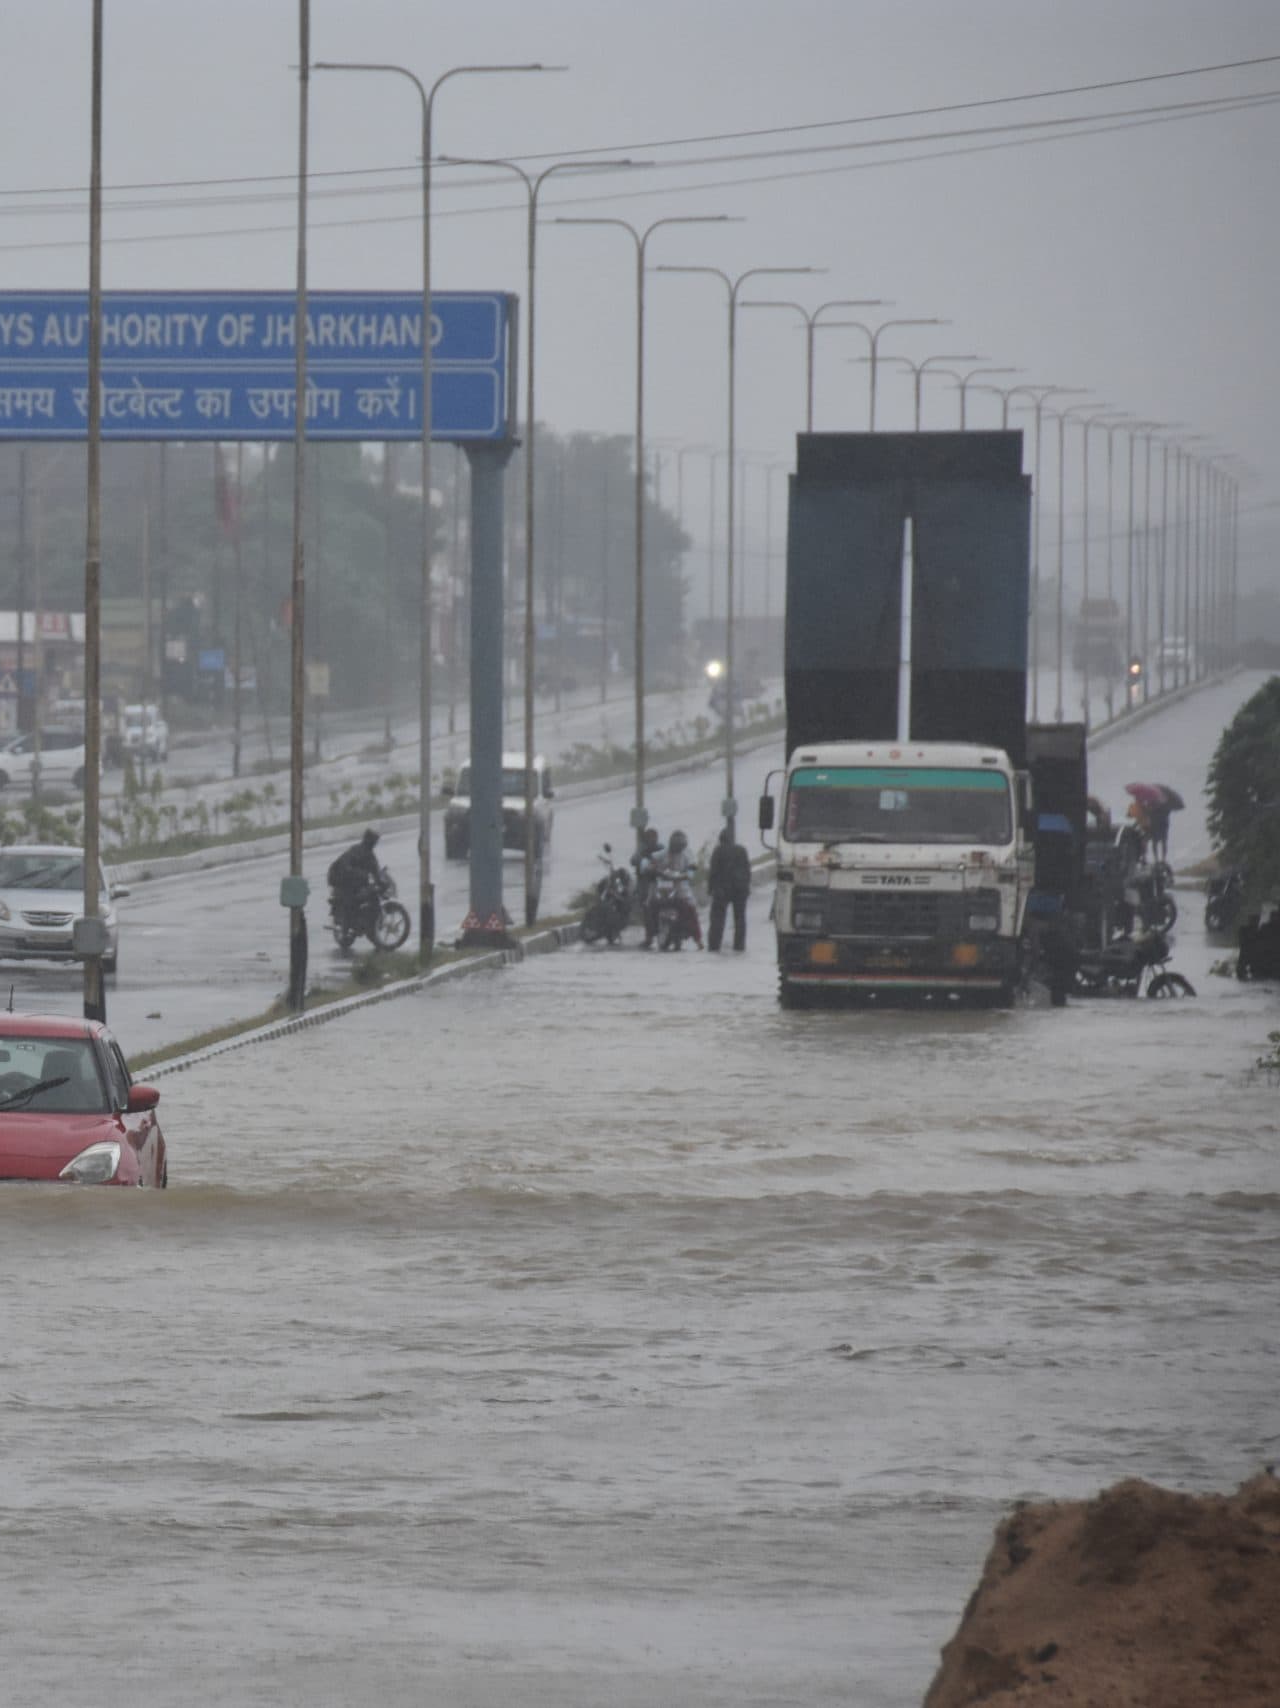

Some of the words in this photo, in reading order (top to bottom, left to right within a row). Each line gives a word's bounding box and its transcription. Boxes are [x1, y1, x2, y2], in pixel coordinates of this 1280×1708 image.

[218, 313, 255, 347] OF
[194, 388, 232, 418] का
[880, 874, 911, 886] TATA
